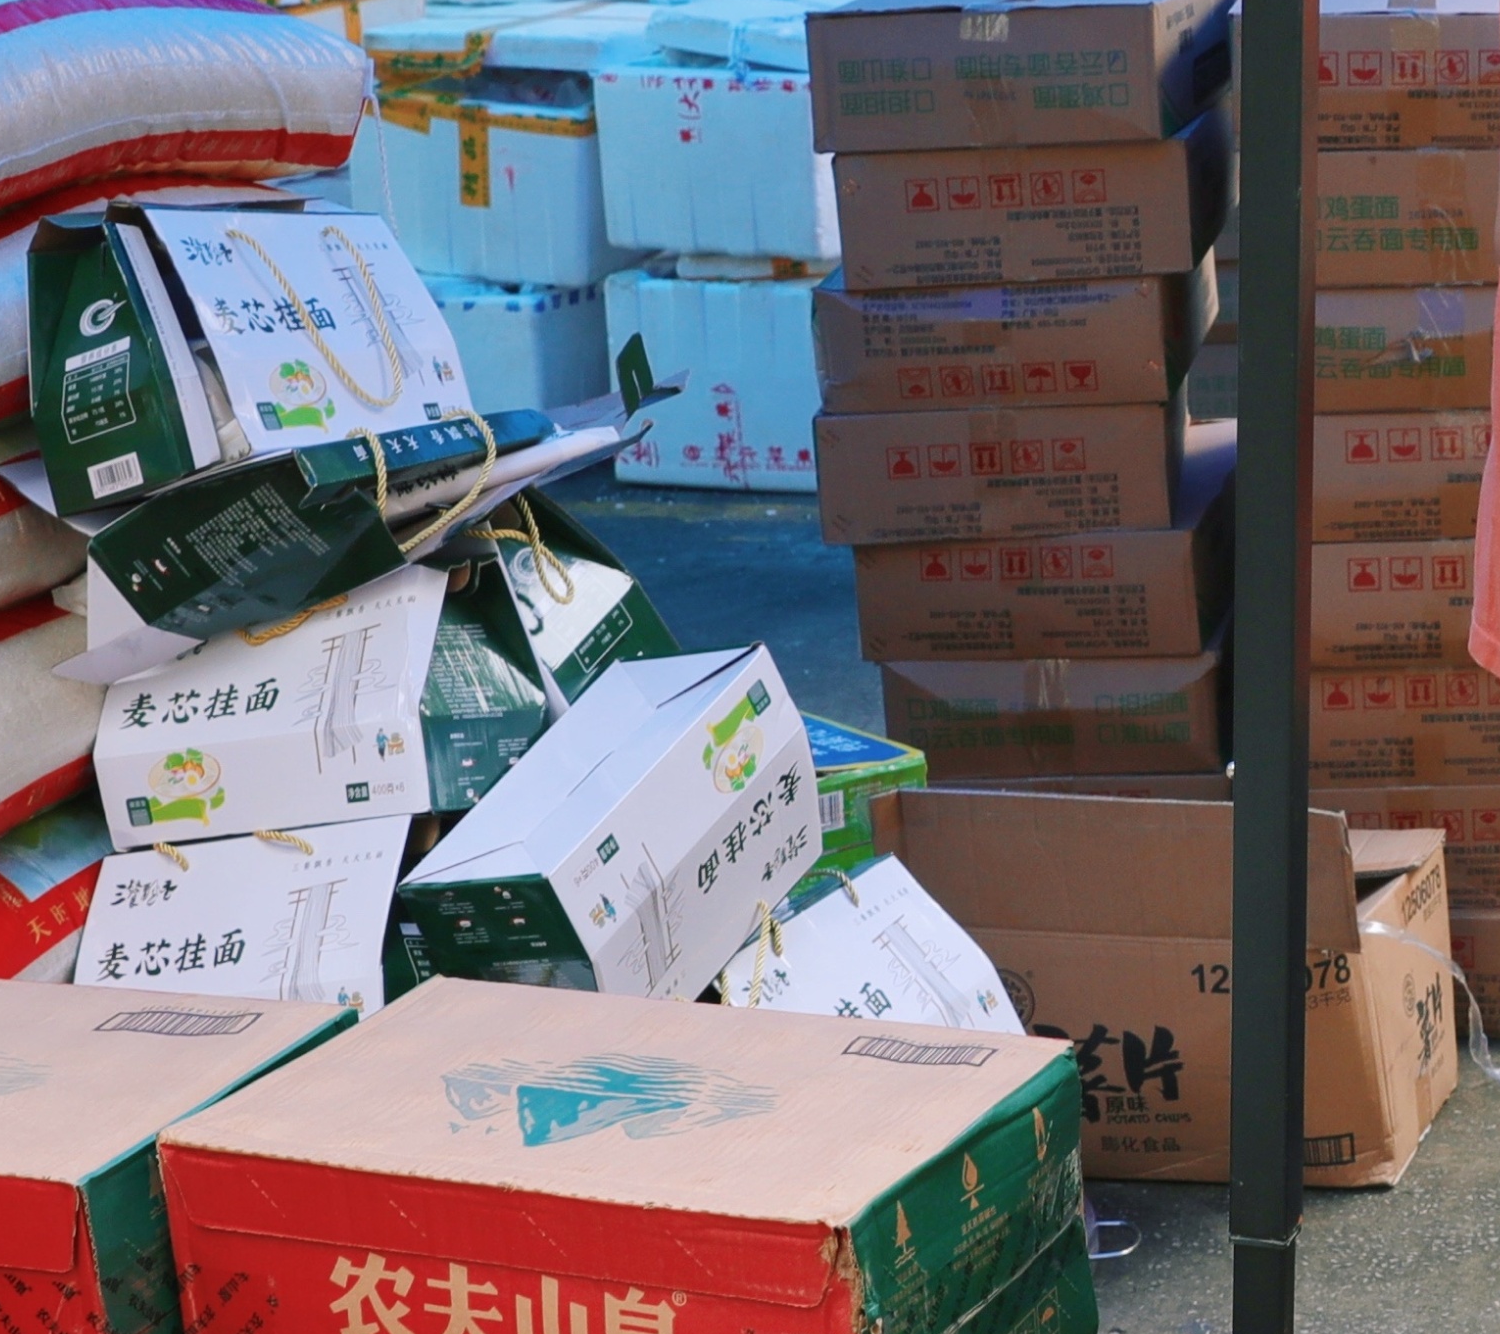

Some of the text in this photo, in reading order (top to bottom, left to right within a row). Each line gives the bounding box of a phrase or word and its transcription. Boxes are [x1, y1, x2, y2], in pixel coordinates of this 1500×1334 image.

[1326, 195, 1400, 220] 鸡蛋面
[1326, 226, 1480, 252] 云吞面专用面
[215, 298, 336, 337] 麦芯挂面
[120, 676, 282, 732] 麦芯挂面
[699, 761, 803, 890] 麦芯挂面
[1401, 863, 1443, 926] 12506078
[97, 929, 247, 982] 麦芯挂面
[1105, 1096, 1149, 1114] 原味
[1105, 1112, 1192, 1126] POTATO CHIPS
[1101, 1135, 1182, 1154] 膨化食品
